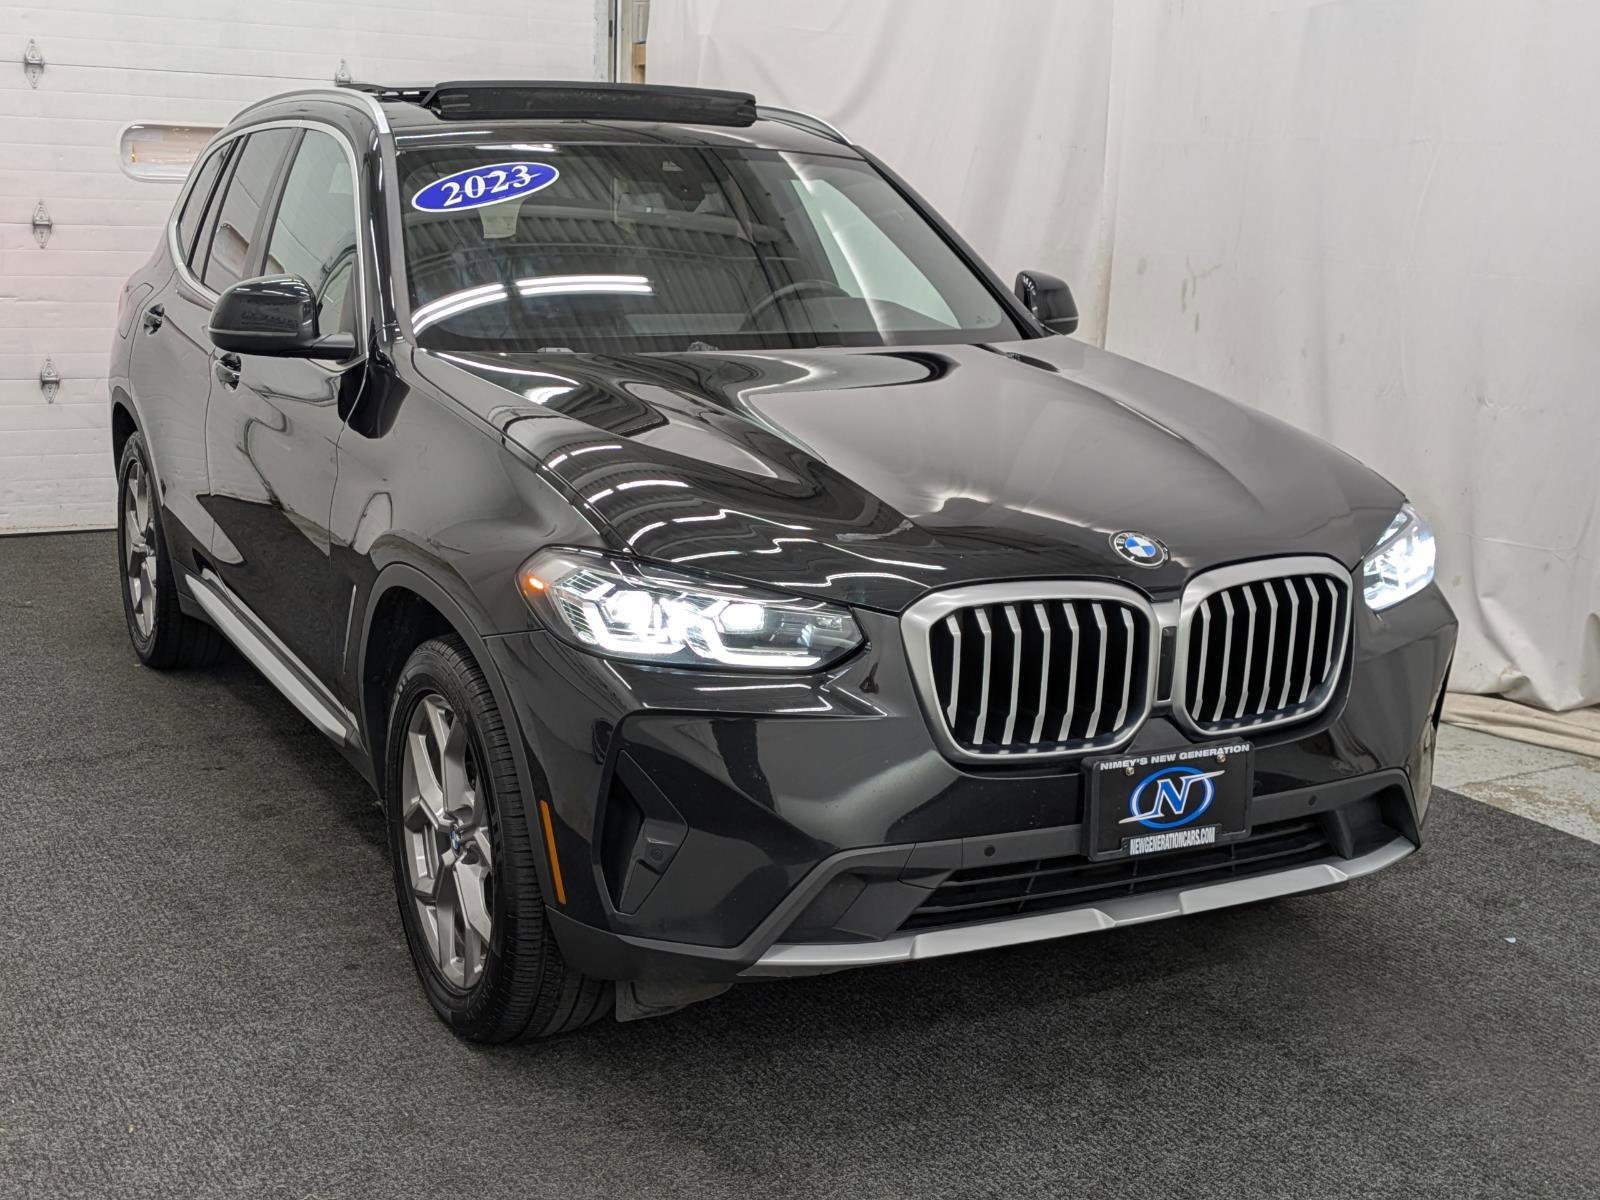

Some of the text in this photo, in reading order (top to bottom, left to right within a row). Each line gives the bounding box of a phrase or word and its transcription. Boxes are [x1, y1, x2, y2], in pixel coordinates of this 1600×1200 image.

[441, 165, 531, 206] 2023
[1100, 744, 1250, 770] NIMEY'S NEW GENERATION
[1130, 826, 1216, 855] NEWGENERATIONCARS.COM
